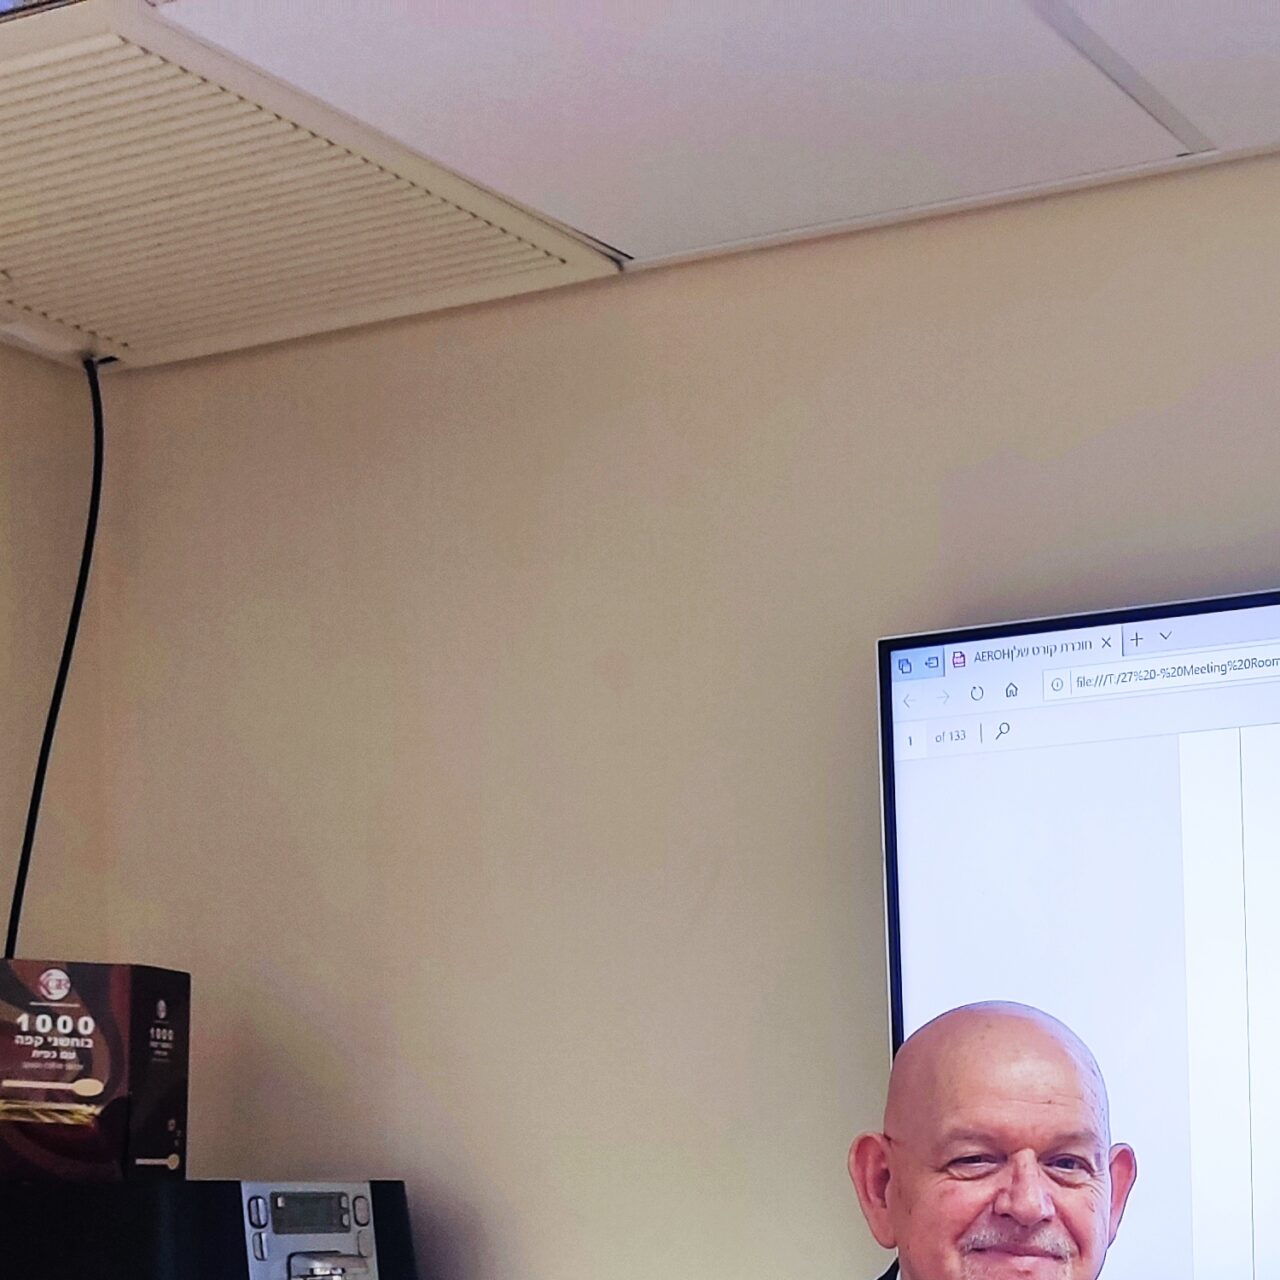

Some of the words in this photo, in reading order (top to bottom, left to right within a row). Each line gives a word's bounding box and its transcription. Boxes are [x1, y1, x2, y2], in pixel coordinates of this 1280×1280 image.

[1032, 644, 1057, 658] קורס
[935, 731, 945, 743] of
[950, 729, 966, 741] 133
[16, 1013, 95, 1035] 1000
[14, 1035, 44, 1047] קפה
